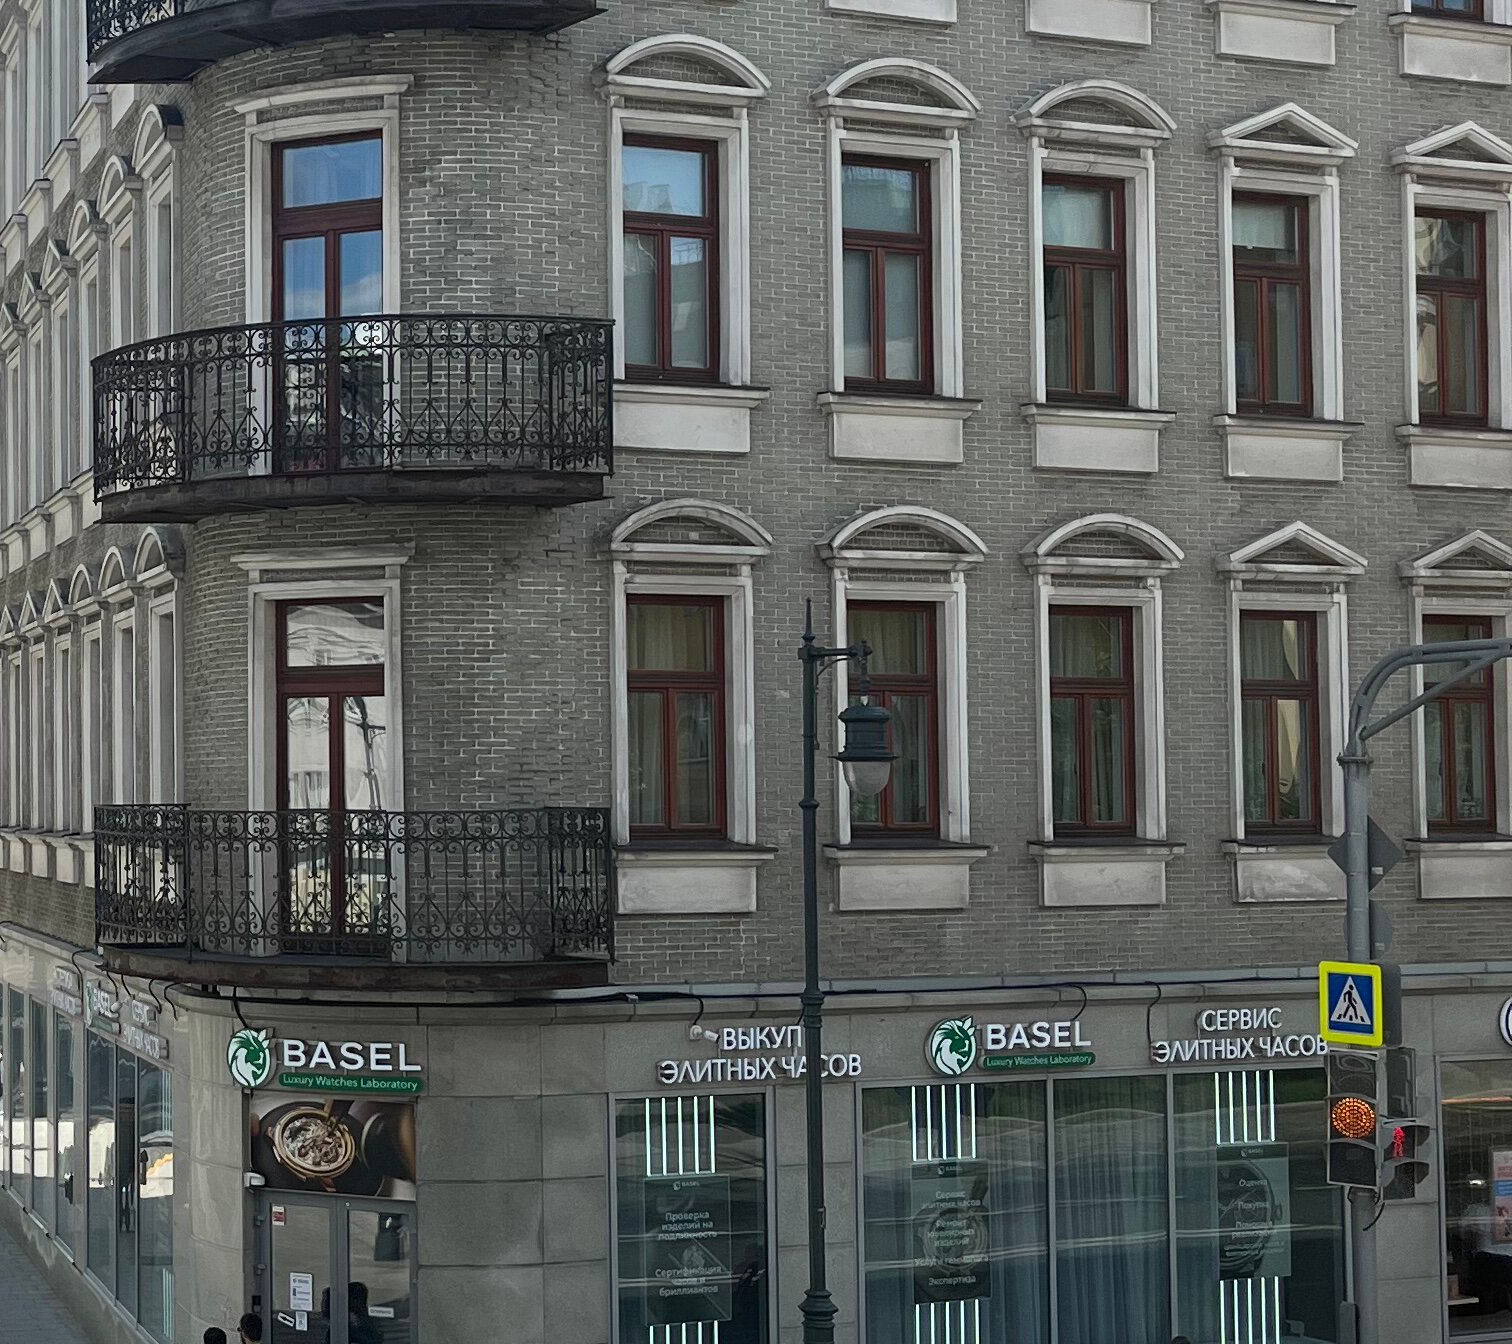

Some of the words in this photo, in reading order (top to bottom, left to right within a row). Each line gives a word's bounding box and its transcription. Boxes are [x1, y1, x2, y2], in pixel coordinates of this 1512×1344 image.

[1202, 1007, 1283, 1031] СЕРВИС
[723, 1025, 802, 1051] ВЫКУП
[987, 1021, 1092, 1050] BASEL
[283, 1039, 422, 1072] BASEL
[1154, 1037, 1255, 1063] ЭЛИТНЫХ
[1259, 1034, 1329, 1057] ЧАСОВ
[661, 1056, 777, 1084] ЭЛИТНЫХ
[987, 1057, 1013, 1068] Luxury
[1014, 1055, 1048, 1066] Watches
[1050, 1054, 1092, 1064] Laboratory
[283, 1074, 314, 1086] Luxury
[315, 1076, 358, 1088] Watches
[360, 1078, 418, 1091] Laboratory
[661, 1222, 701, 1231] изделий
[702, 1221, 714, 1229] на
[665, 1211, 710, 1222] Проверка
[655, 1266, 722, 1278] Сертификация
[659, 1285, 719, 1297] бриллиантов
